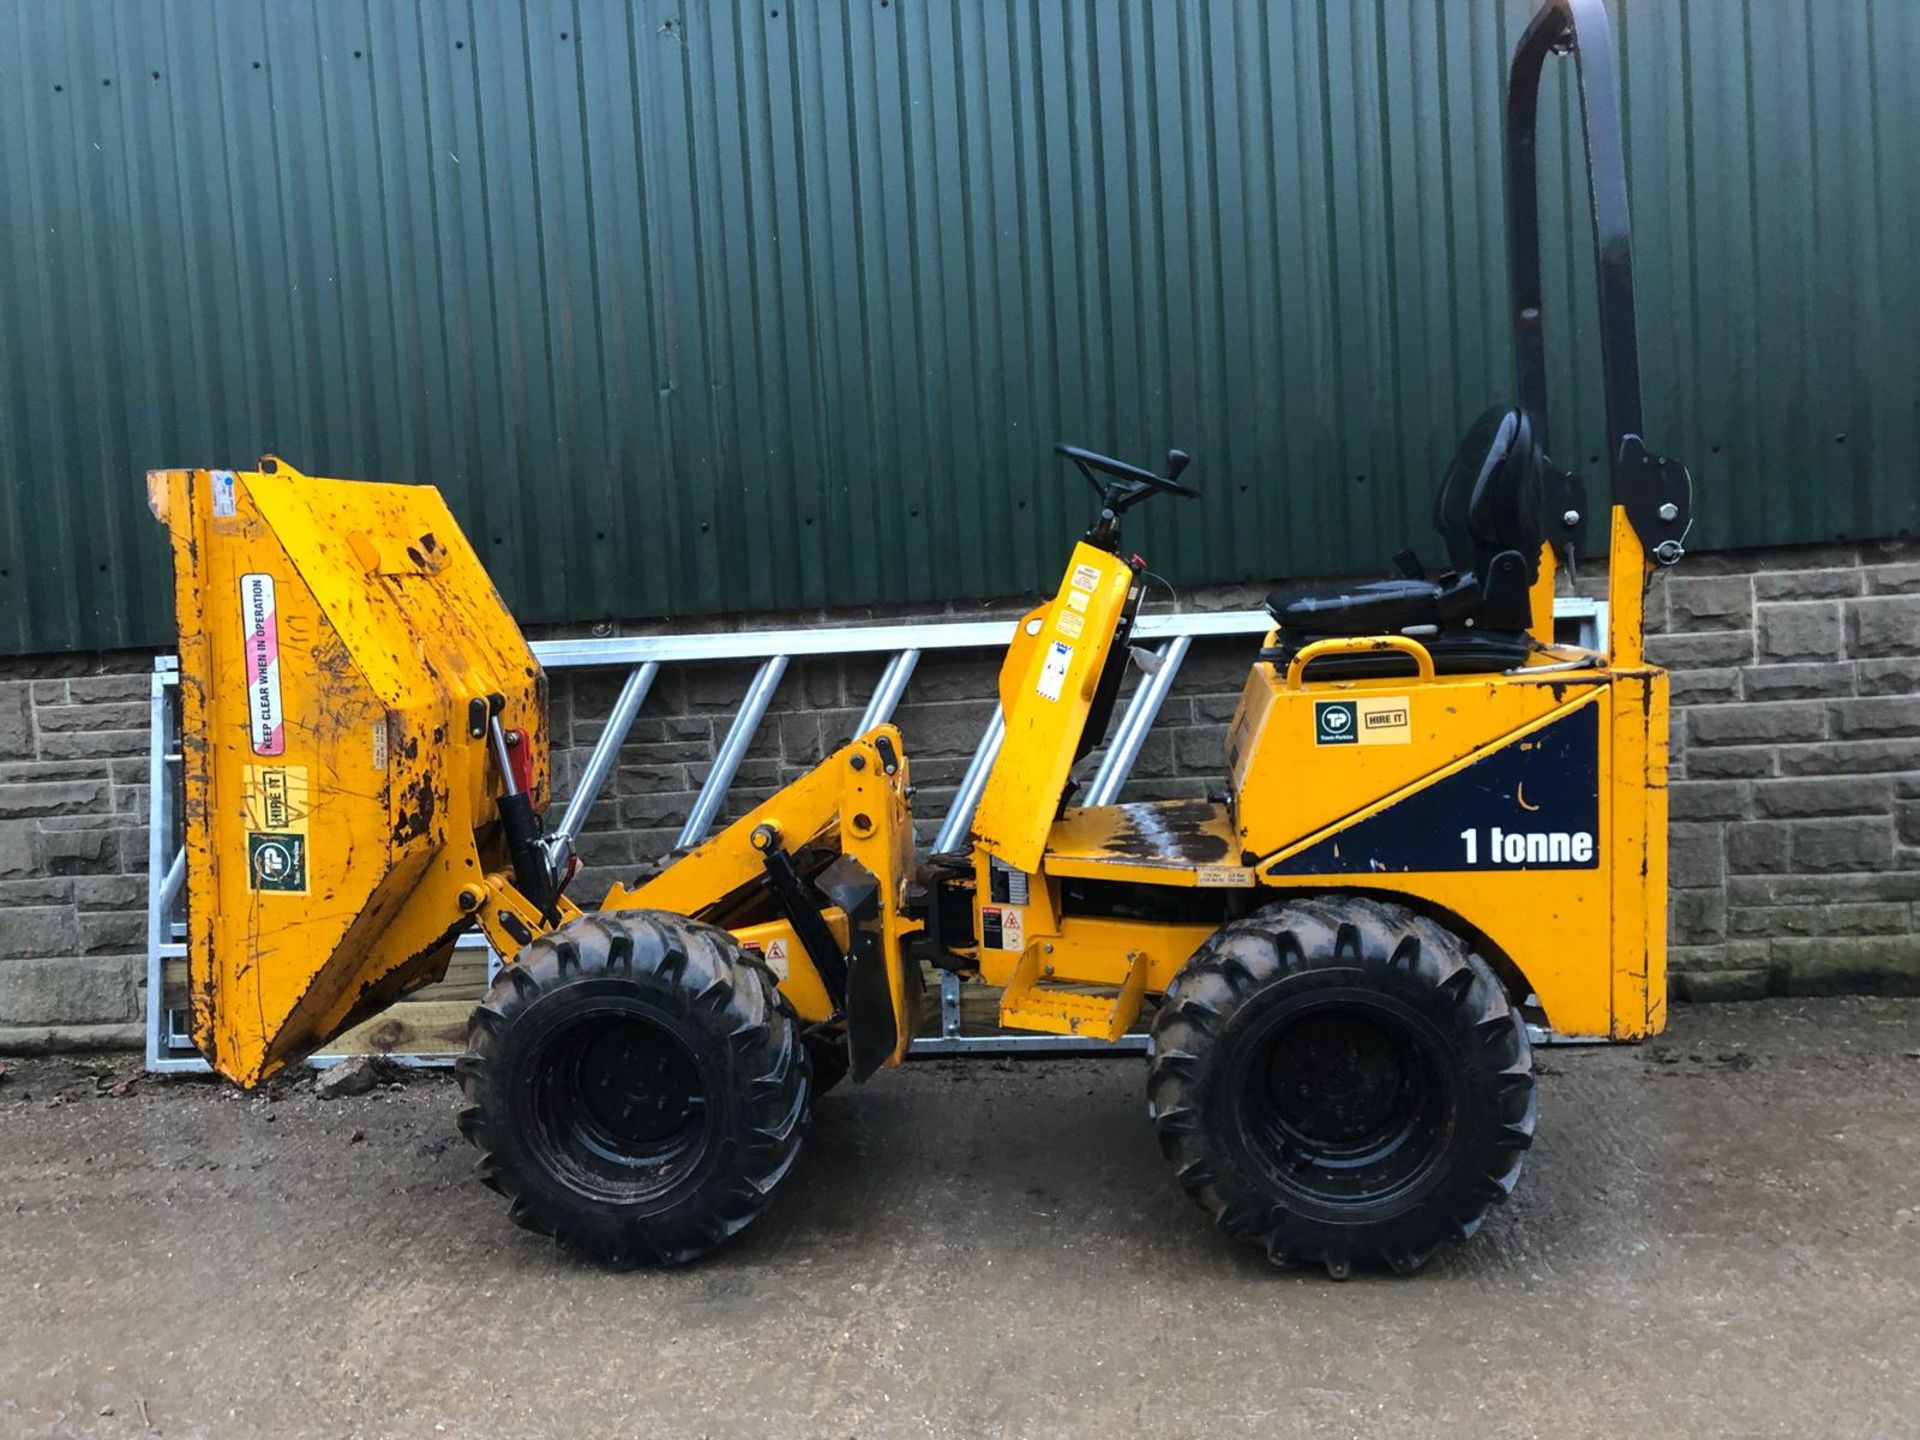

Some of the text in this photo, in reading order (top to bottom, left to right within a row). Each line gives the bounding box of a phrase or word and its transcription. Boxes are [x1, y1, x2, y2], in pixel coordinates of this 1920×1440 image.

[252, 580, 273, 749] KEEP CLEAR WHEN IN OPERATION
[1326, 713, 1347, 728] TP
[1369, 713, 1402, 725] HIRE IT
[269, 777, 283, 823] HIRE IT
[1461, 827, 1593, 863] 1 tonne
